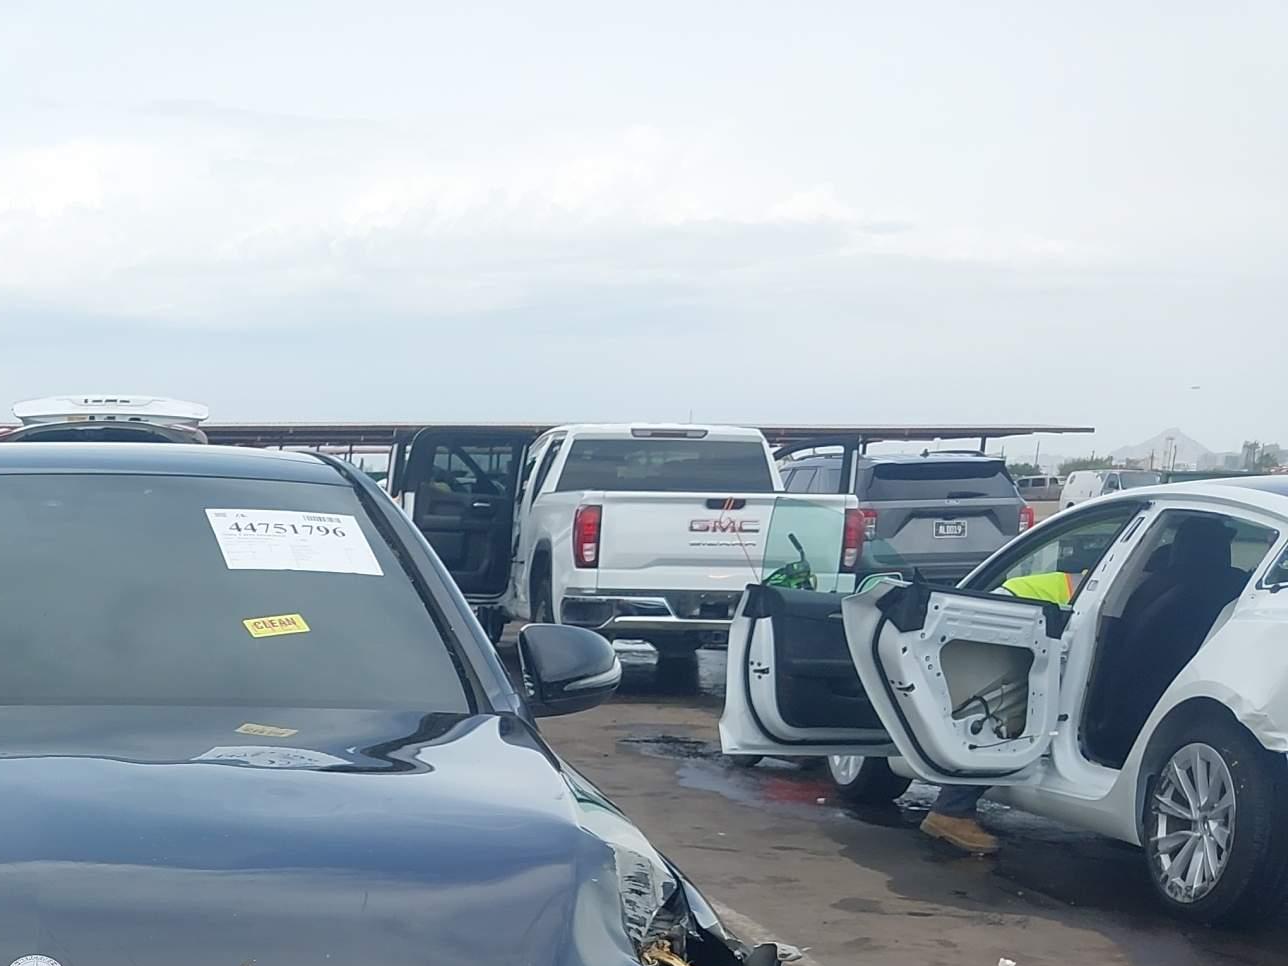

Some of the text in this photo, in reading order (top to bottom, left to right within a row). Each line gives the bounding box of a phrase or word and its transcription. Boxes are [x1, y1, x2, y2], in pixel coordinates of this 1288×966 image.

[228, 521, 346, 538] 44751796
[688, 519, 760, 533] GMC
[253, 617, 297, 630] CLEAN
